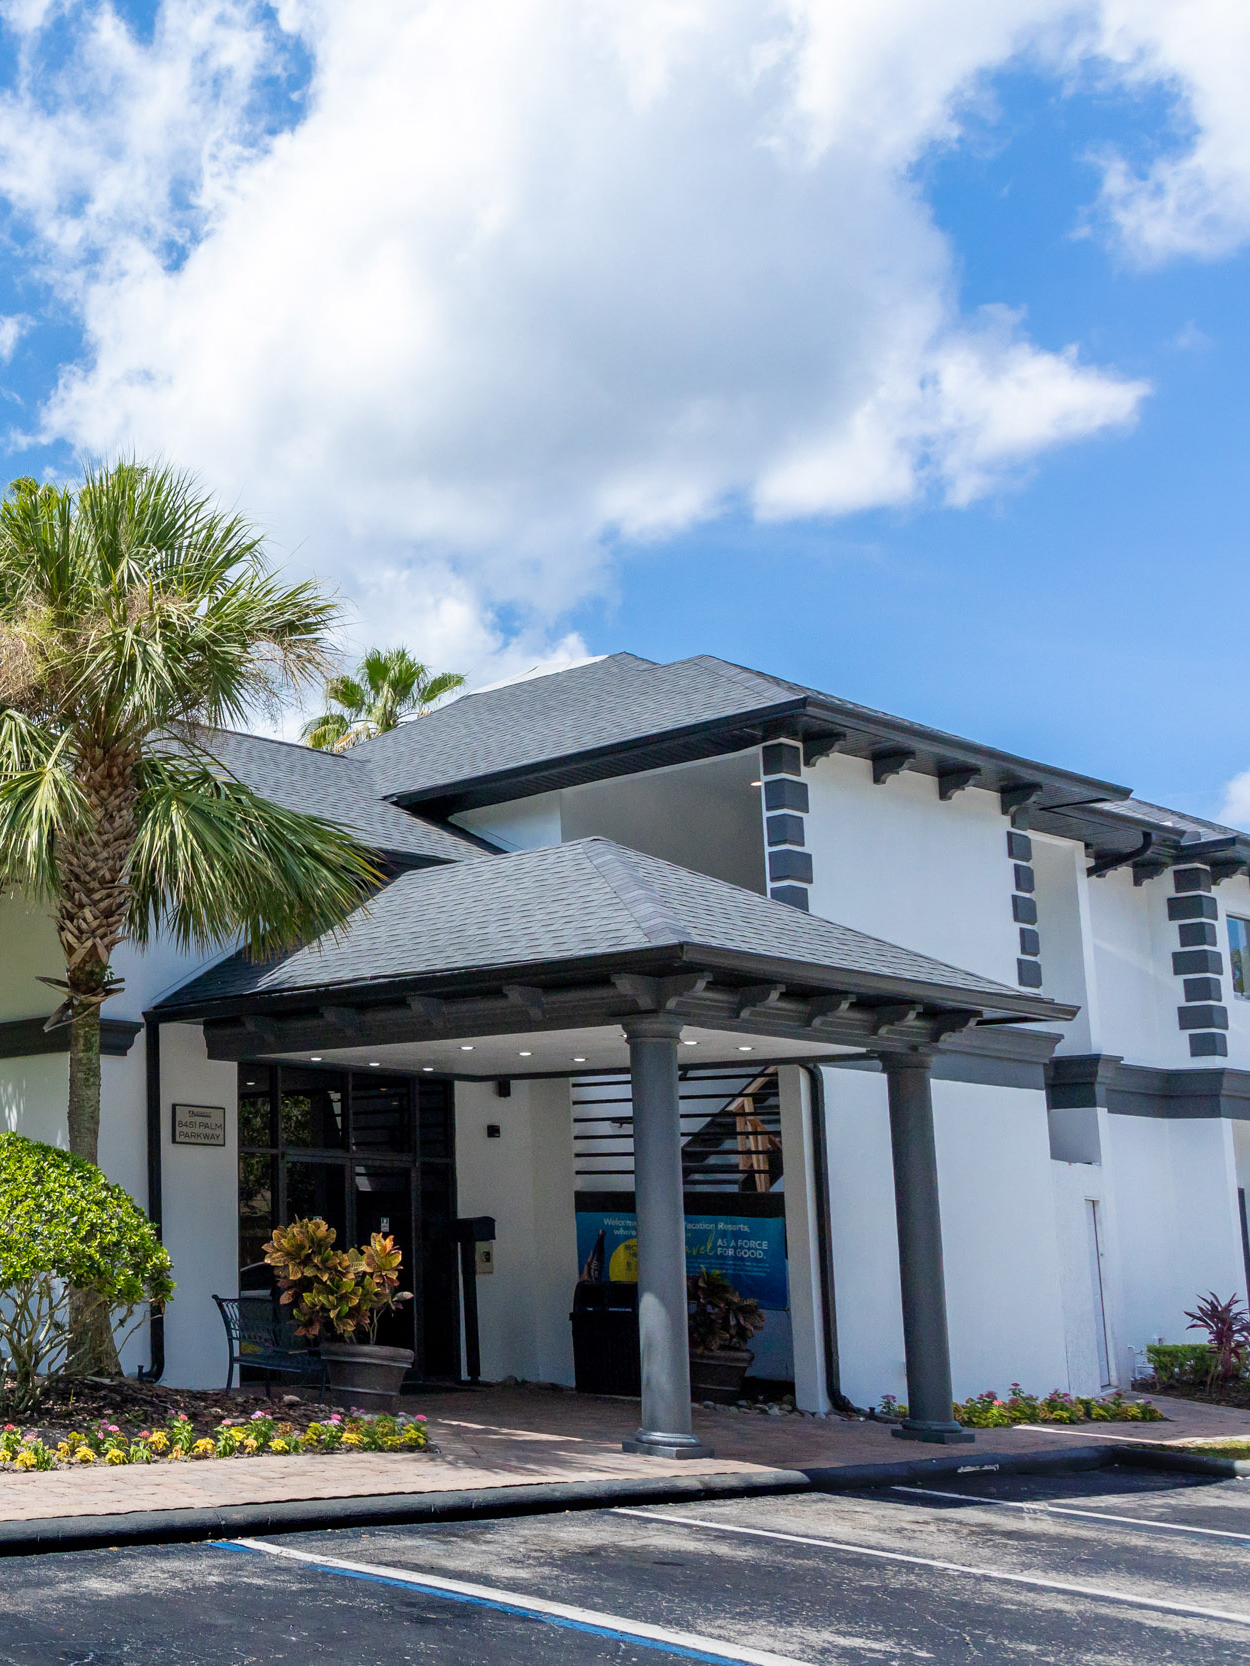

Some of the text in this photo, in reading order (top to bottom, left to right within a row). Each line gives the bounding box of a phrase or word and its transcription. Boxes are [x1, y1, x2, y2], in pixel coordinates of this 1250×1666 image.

[177, 1120, 223, 1131] 8451 PALM
[178, 1131, 221, 1140] PARKWAY
[684, 1221, 715, 1230] acation
[717, 1222, 750, 1232] Resorts,
[716, 1238, 769, 1250] AS A FORCE
[717, 1247, 767, 1259] FOR GOOD.
